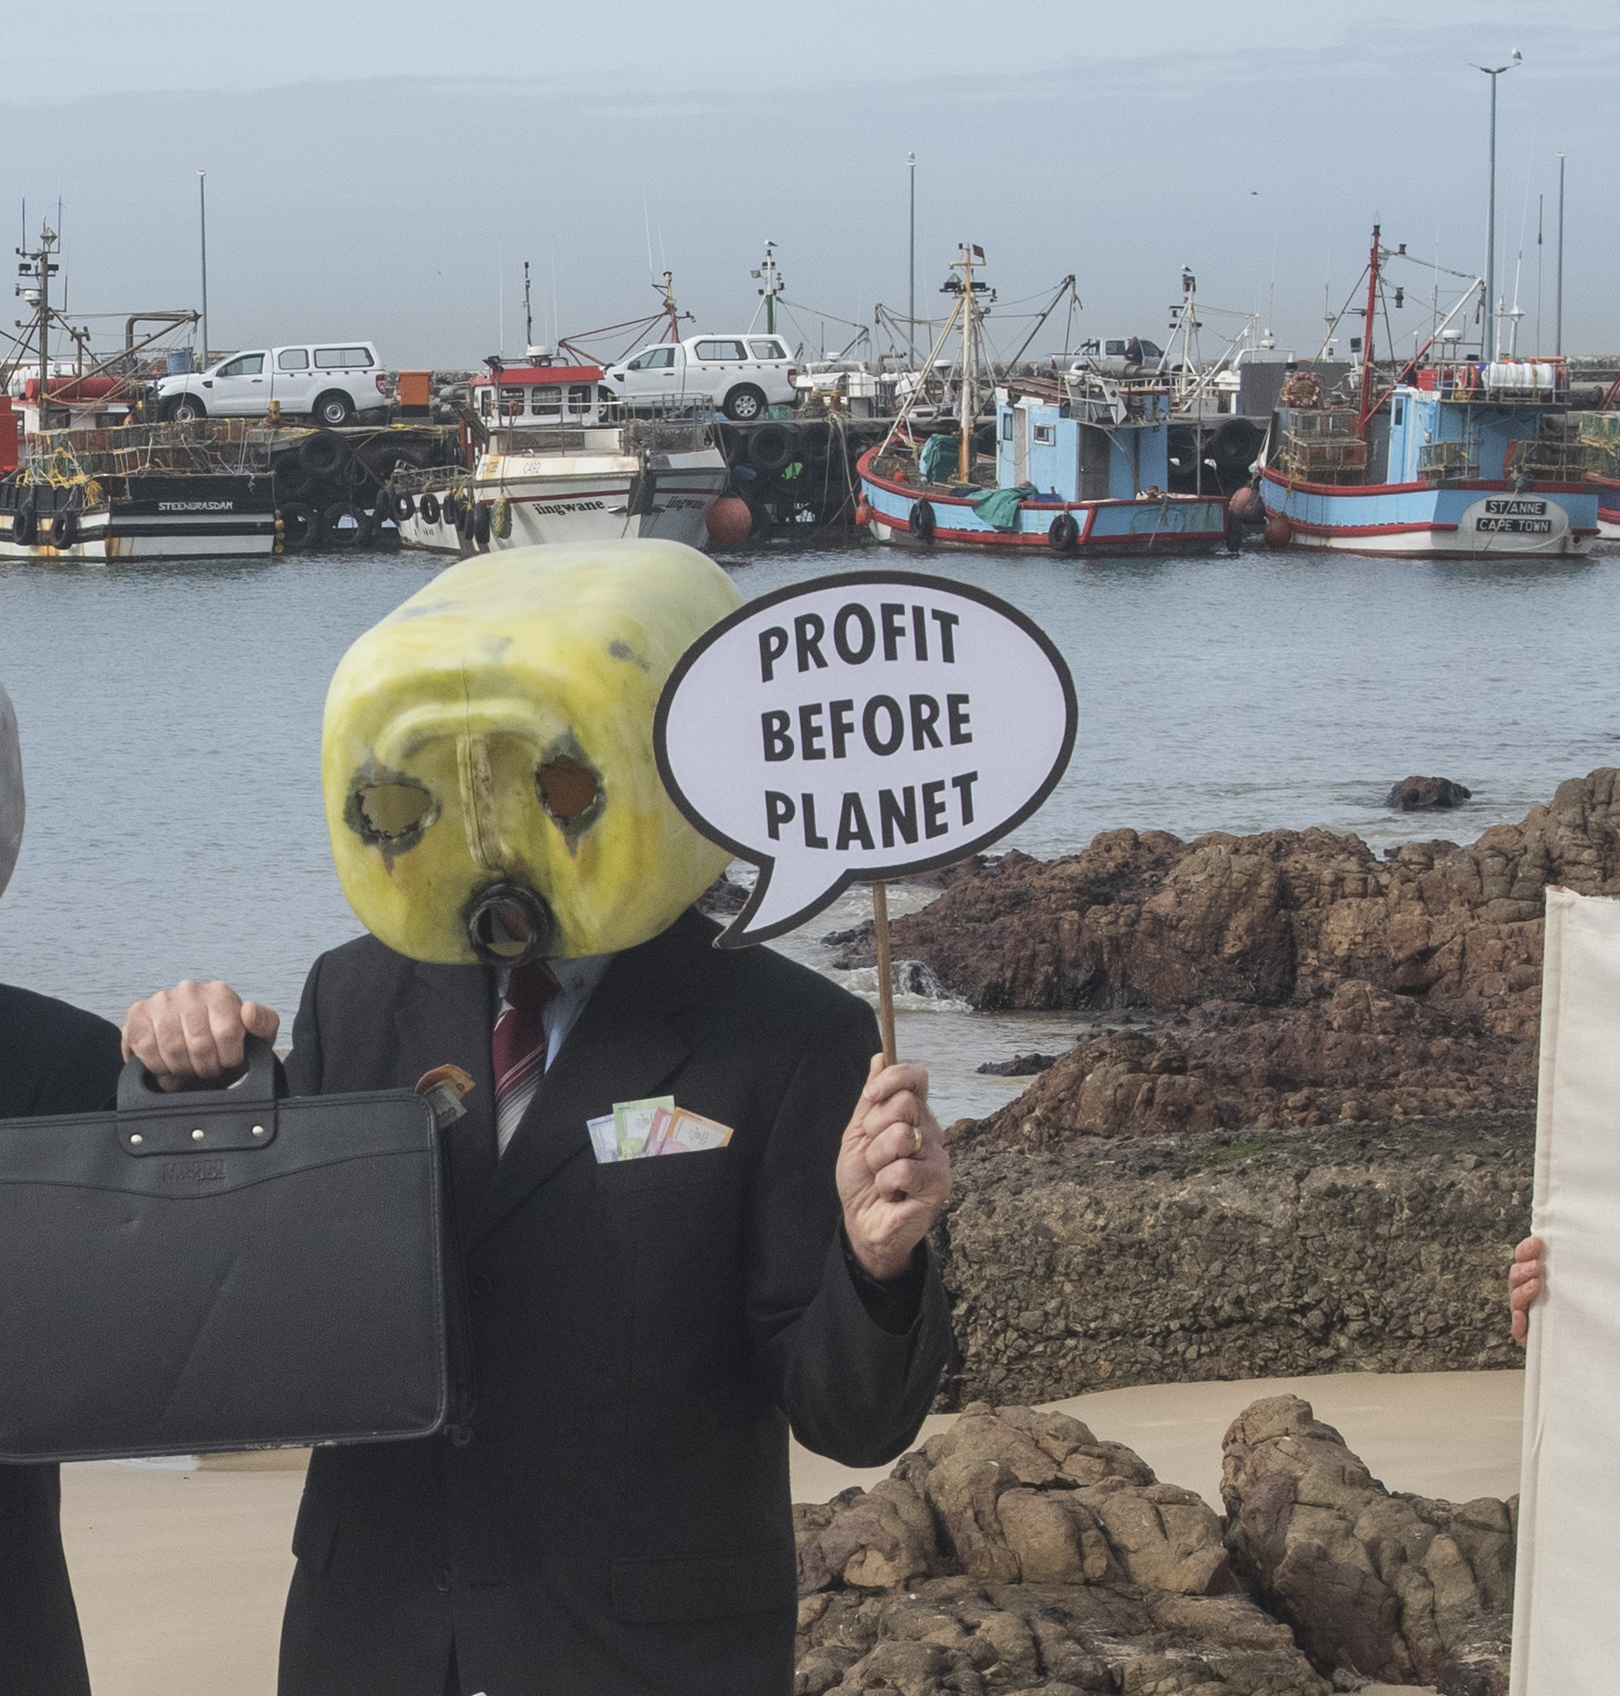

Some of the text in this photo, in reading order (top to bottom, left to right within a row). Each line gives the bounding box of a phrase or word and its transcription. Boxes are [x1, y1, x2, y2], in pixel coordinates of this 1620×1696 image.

[1479, 519, 1549, 532] CAPE TOWN
[1489, 501, 1542, 514] ST ANNE
[758, 602, 960, 683] PROFIT
[760, 693, 974, 762] BEFORE
[763, 770, 979, 851] PLANET
